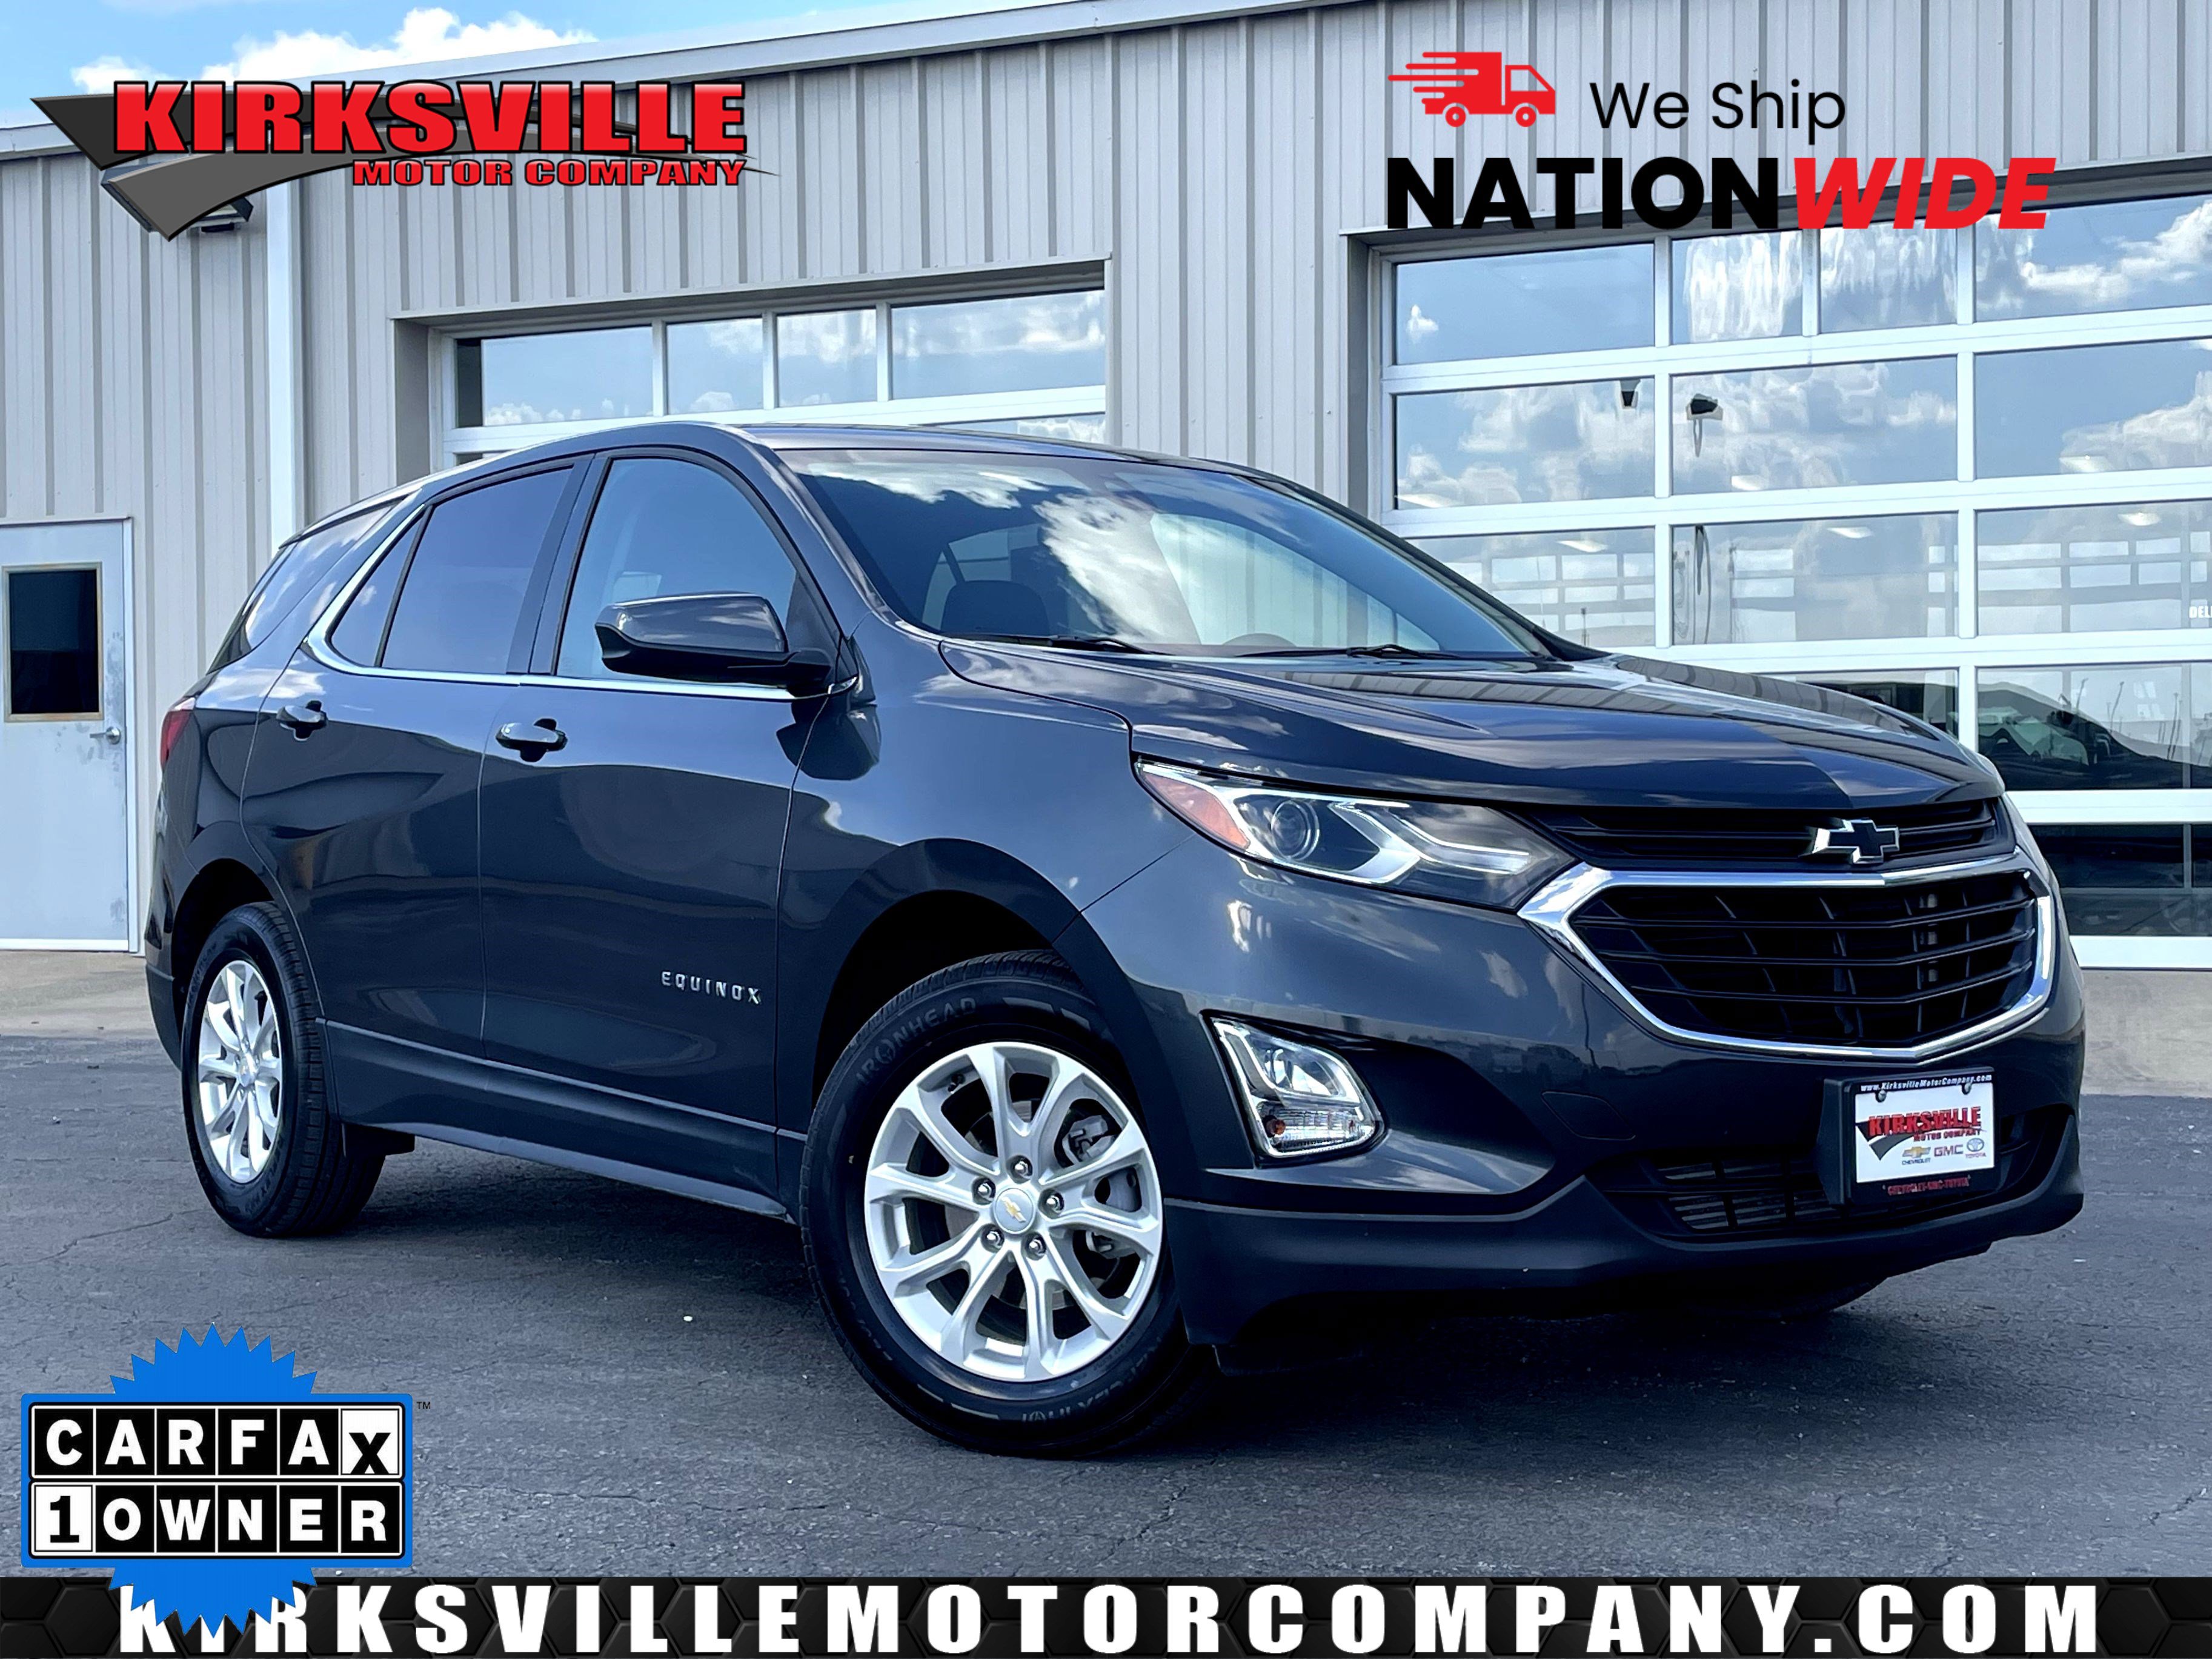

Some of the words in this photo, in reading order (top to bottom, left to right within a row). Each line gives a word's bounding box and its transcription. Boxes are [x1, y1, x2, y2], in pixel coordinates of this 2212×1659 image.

[2189, 606, 2212, 618] DEL
[661, 971, 762, 1005] EQUINOX
[855, 997, 976, 1083] IRONHEAD
[1867, 1106, 1981, 1136] KIRKSVILLE
[1934, 1144, 1964, 1157] GMC
